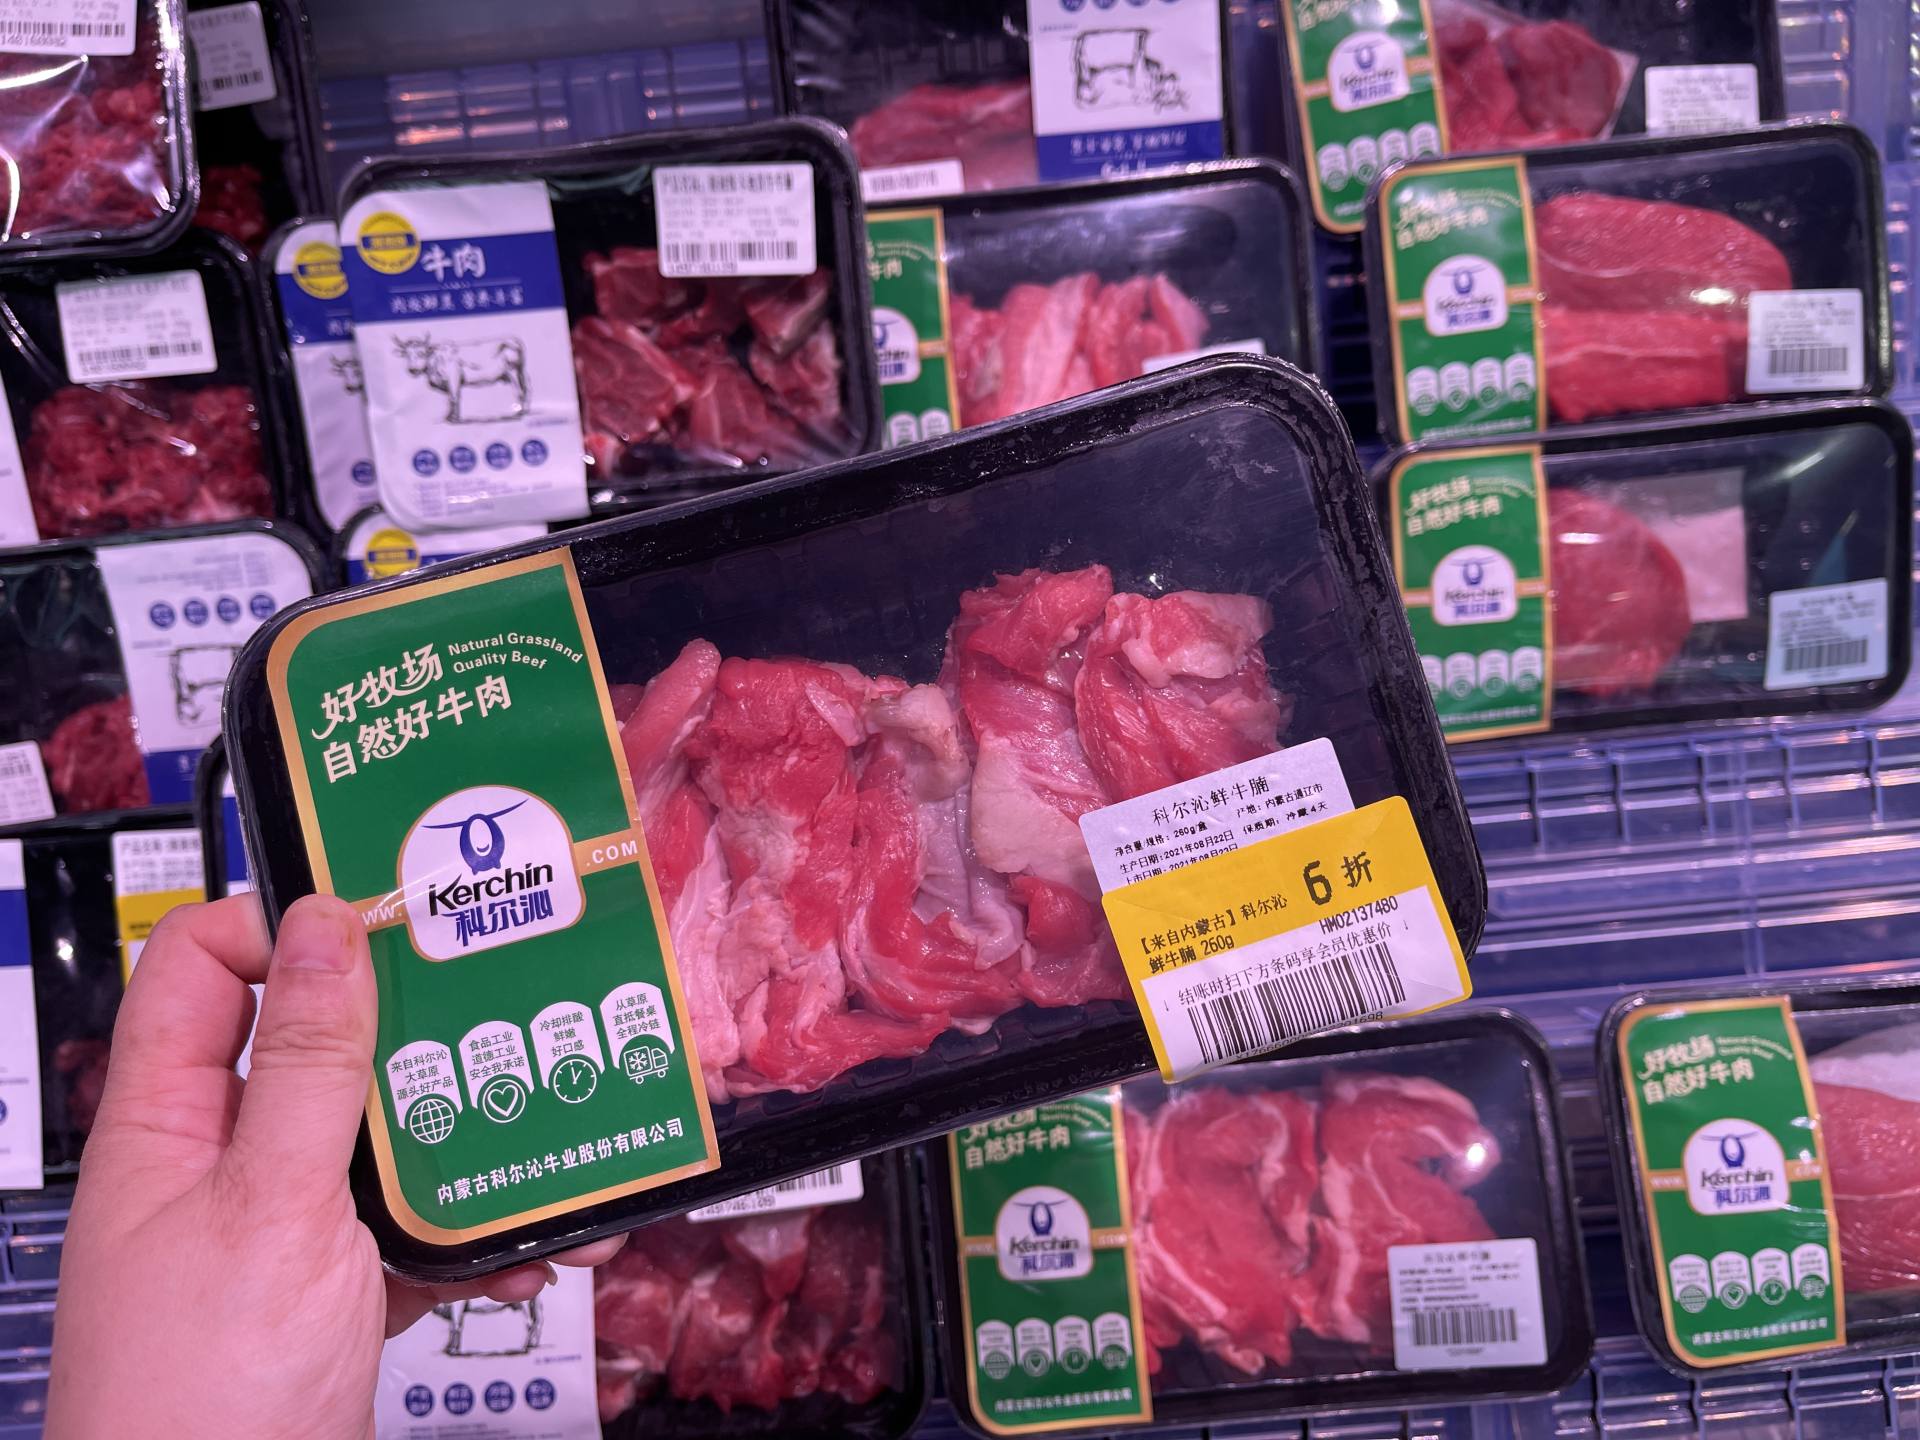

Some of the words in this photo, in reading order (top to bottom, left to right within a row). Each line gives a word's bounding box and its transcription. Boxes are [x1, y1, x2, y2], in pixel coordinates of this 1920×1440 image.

[420, 242, 486, 282] 牛肉
[448, 633, 504, 657] Natural
[507, 631, 585, 664] Grassland
[453, 653, 507, 674] Quality
[512, 650, 548, 671] Beef
[311, 642, 444, 740] 好牧场
[321, 674, 513, 784] 自然好牛肉
[1152, 775, 1270, 826] 科尔沁鲜牛腩
[585, 839, 639, 868] .COM
[428, 863, 554, 916] Kerchin
[358, 904, 402, 926] WW.
[616, 993, 648, 1011] 从草原
[540, 1011, 584, 1031] 冷却排酸
[613, 1005, 657, 1027] 直抵餐桌
[616, 1018, 661, 1040] 全程冷链
[469, 1031, 514, 1052] 食品工业
[551, 1040, 585, 1057] 好口感
[391, 1049, 448, 1074] 来自科尔沁
[472, 1044, 517, 1066] 道德工业
[405, 1065, 440, 1085] 大草原
[469, 1056, 525, 1080] 安全我承诺
[396, 1076, 454, 1100] 源头好产品
[436, 1117, 684, 1206] 内蒙古科尔沁牛业股份有限公司
